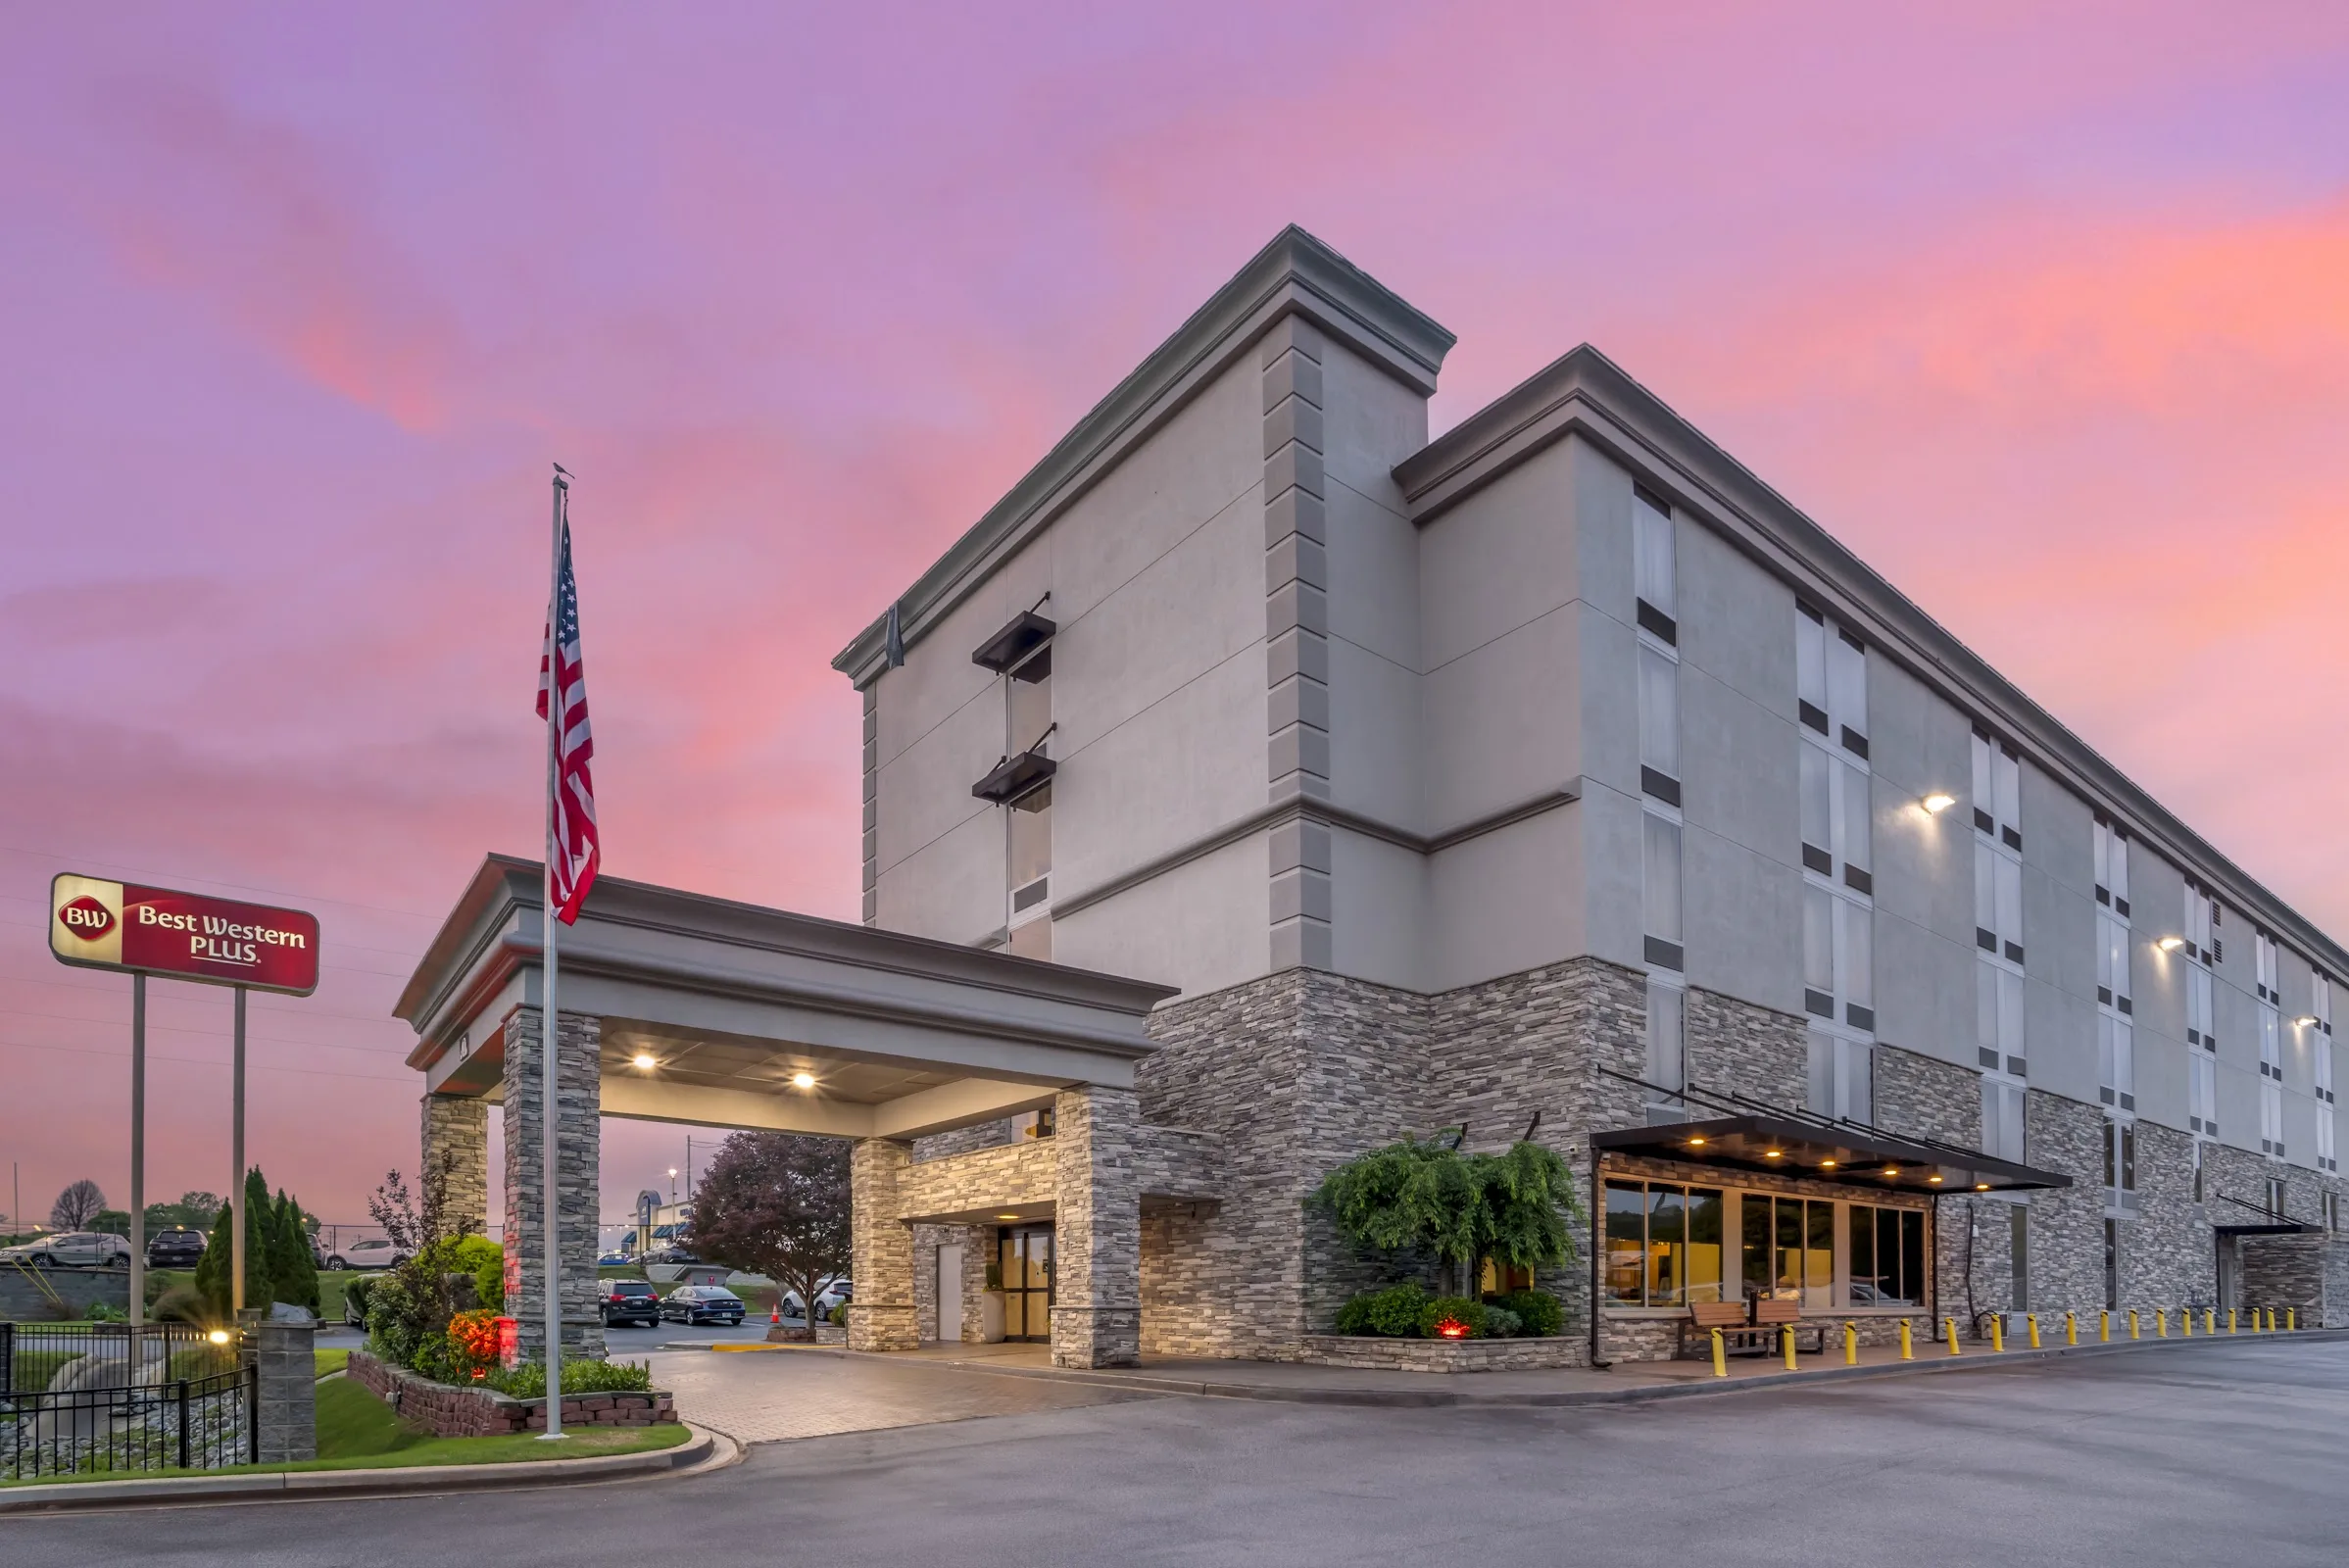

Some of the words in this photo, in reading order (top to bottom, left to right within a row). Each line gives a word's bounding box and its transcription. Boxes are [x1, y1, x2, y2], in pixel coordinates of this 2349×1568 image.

[67, 906, 108, 928] BW
[139, 906, 198, 932] Best
[202, 915, 306, 949] Western
[190, 935, 257, 962] PLUS
